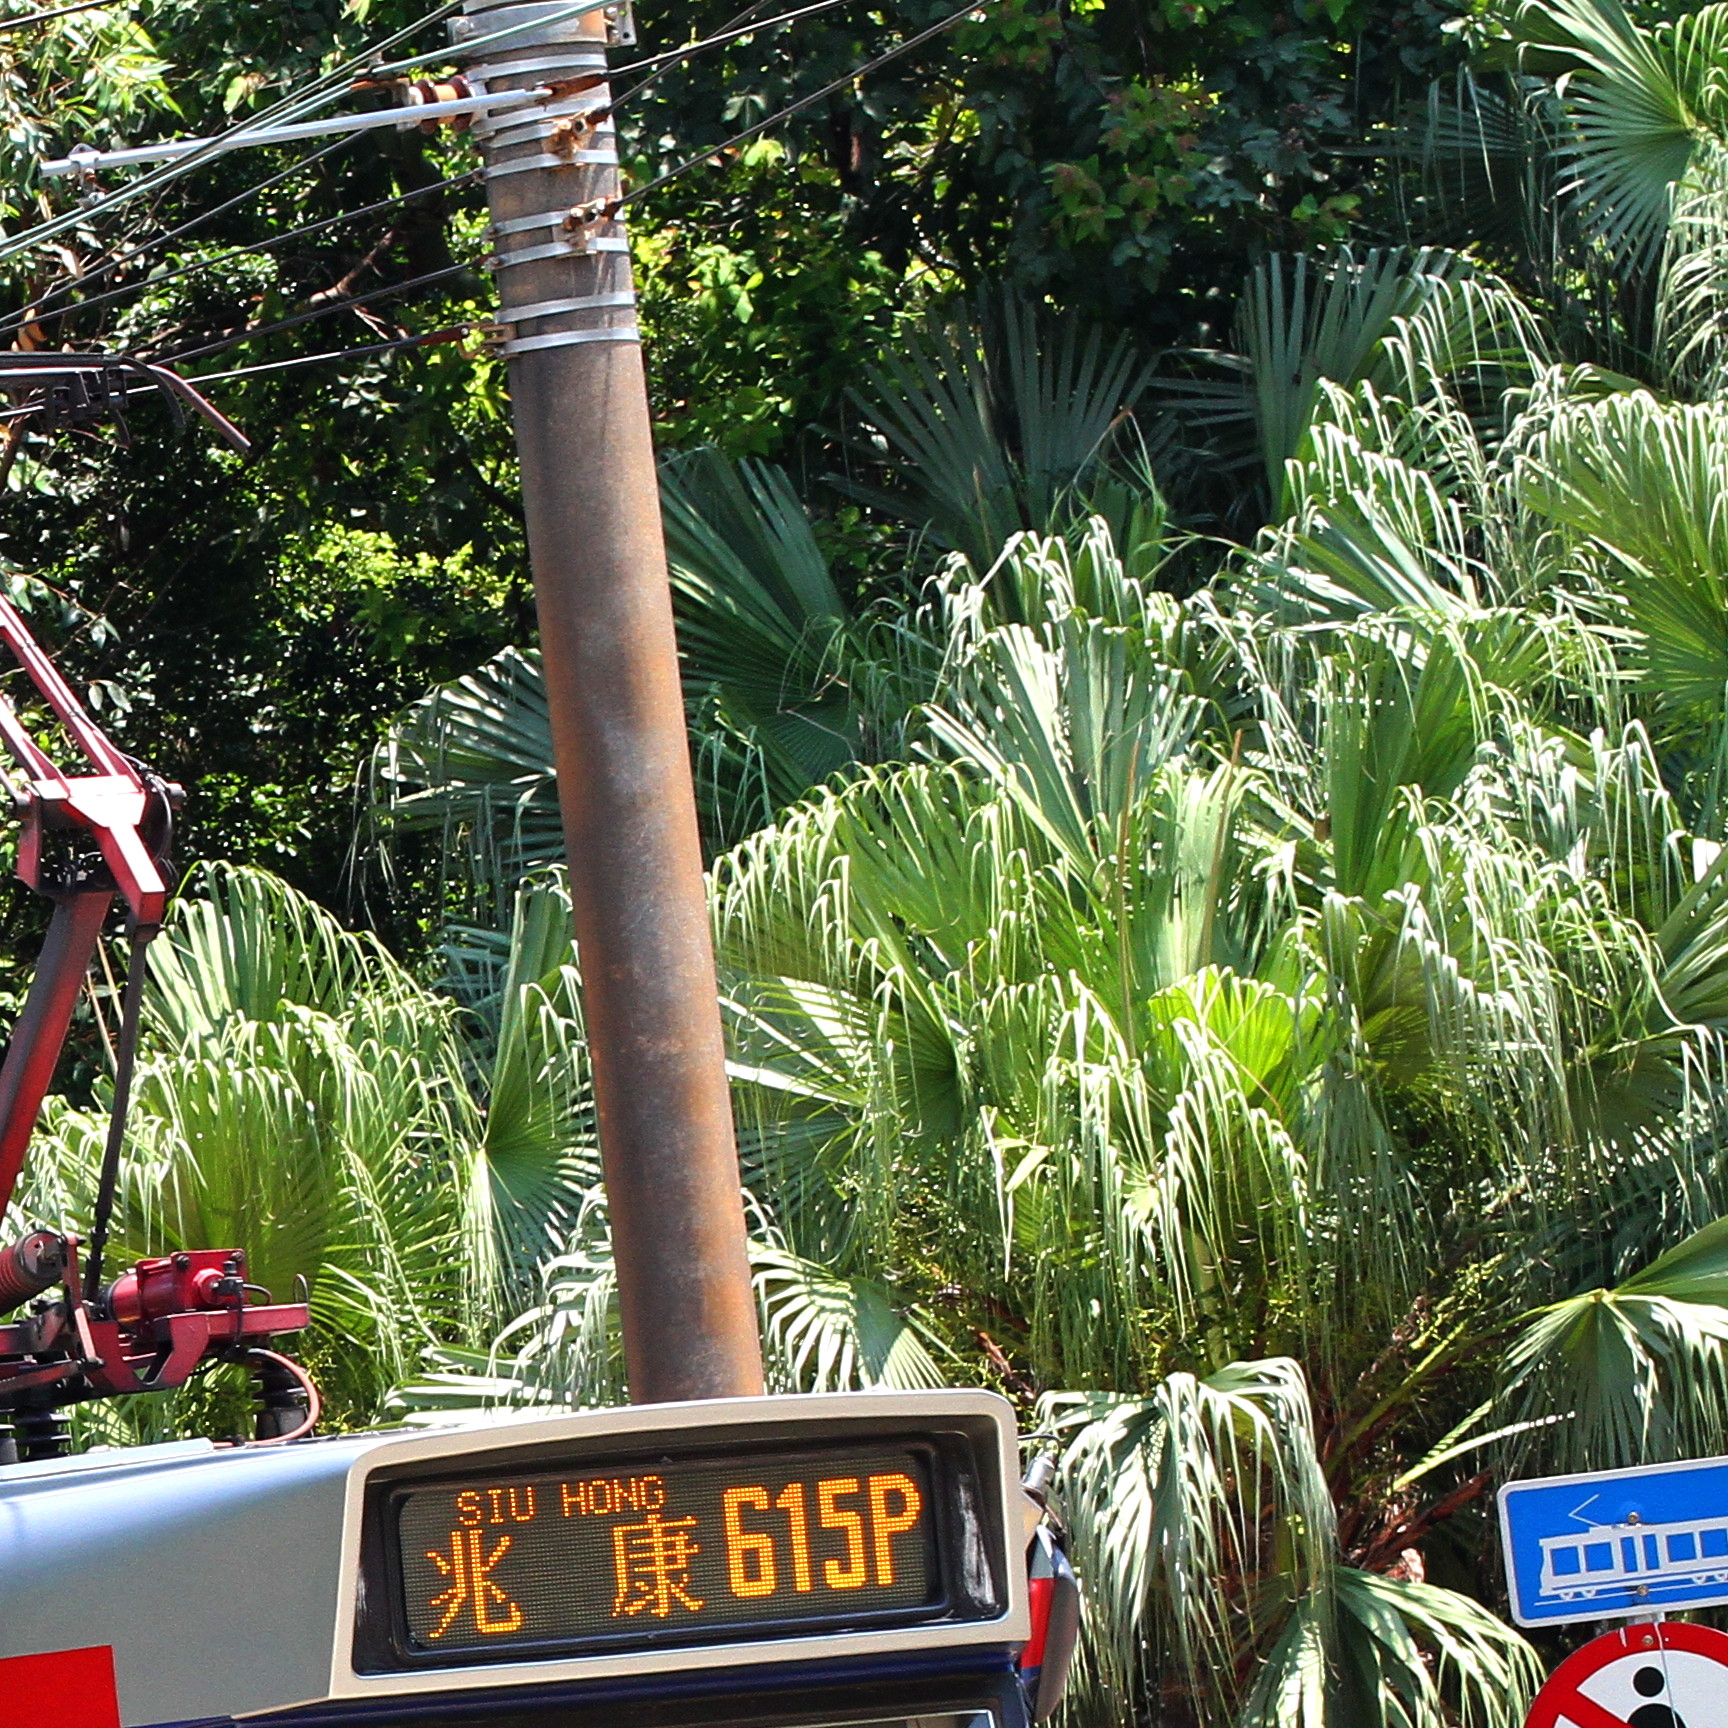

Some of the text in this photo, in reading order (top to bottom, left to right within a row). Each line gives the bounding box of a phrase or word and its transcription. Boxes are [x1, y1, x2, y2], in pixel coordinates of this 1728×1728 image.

[456, 1475, 665, 1526] SIU HONG
[722, 1473, 922, 1599] 615P
